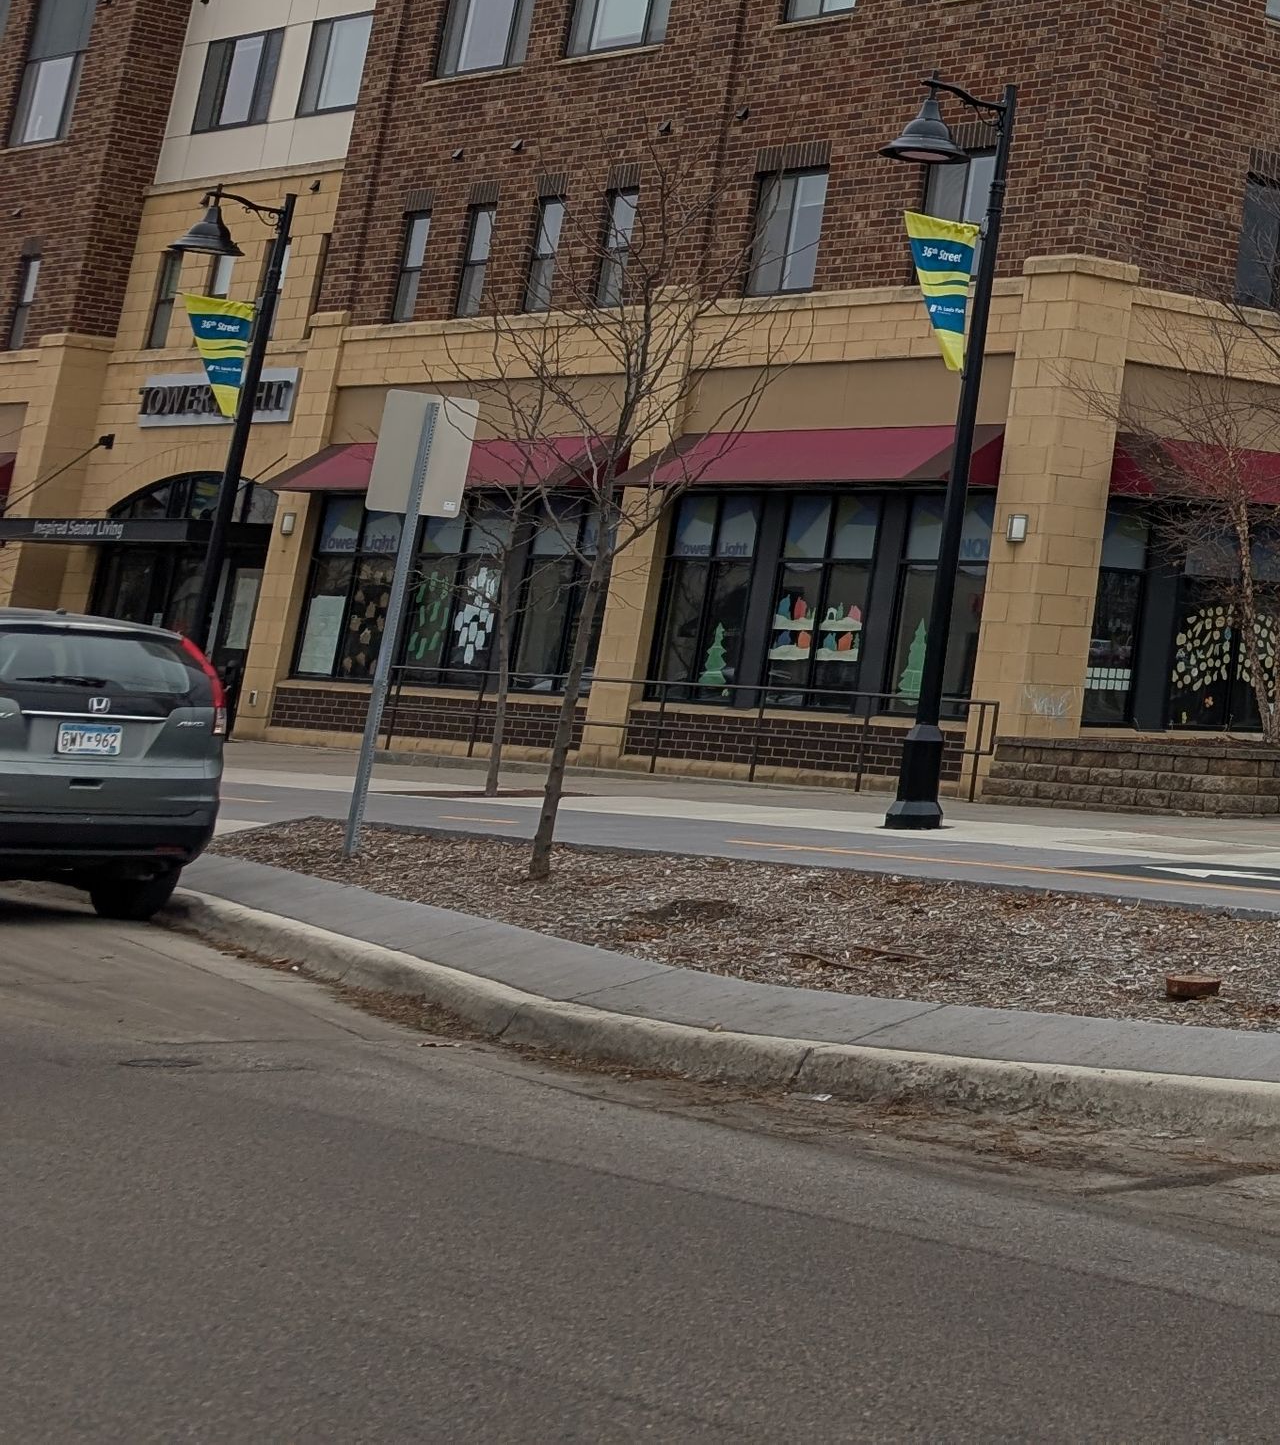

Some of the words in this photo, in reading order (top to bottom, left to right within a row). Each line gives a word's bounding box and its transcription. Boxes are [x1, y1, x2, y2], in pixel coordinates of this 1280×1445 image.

[922, 246, 938, 258] 36th
[938, 249, 961, 262] Street
[201, 320, 216, 328] 36th
[217, 322, 240, 332] Street
[139, 380, 291, 415] TOWERHT
[33, 520, 68, 538] Inspired
[69, 520, 97, 535] Senior
[97, 520, 125, 539] Living
[363, 534, 396, 552] Light
[94, 733, 119, 749] 962
